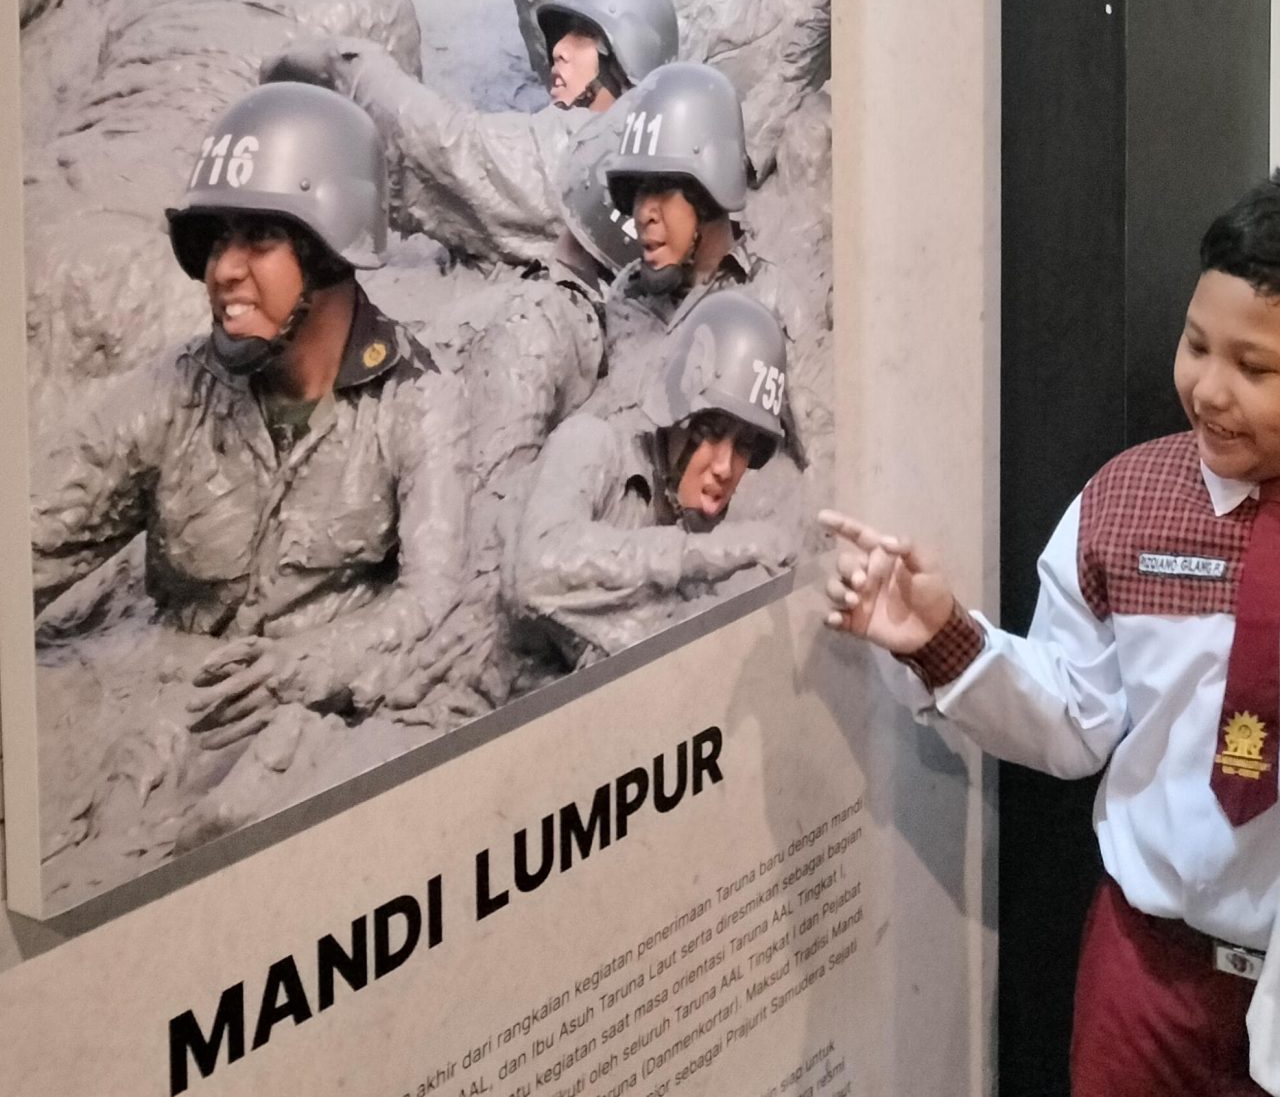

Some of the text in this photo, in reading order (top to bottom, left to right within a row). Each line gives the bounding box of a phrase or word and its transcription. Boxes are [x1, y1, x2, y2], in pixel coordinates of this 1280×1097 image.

[749, 359, 785, 416] 753
[169, 726, 724, 1097] MANDI LUMPUR
[416, 797, 863, 1097] akhir dari rangkaian kegiatan penerimaan Taruna baru dengan mandi
[498, 1052, 526, 1080] dan
[532, 1031, 554, 1059] Ibu
[559, 1005, 595, 1040] Asuh
[599, 973, 645, 1012] Taruna
[648, 950, 677, 981] Laut
[681, 927, 713, 959] serta
[715, 883, 779, 935] diresmikan
[782, 848, 825, 890] sebagai
[827, 826, 862, 860] bagian
[536, 1037, 597, 1090] kegiatan
[601, 1012, 630, 1045] saat
[634, 988, 669, 1023] masa
[672, 947, 726, 994] orientasi
[729, 919, 768, 954] Taruna
[772, 904, 794, 927] AAL
[797, 869, 838, 906] Tingkat
[589, 1053, 618, 1084] oleh
[622, 1016, 671, 1061] seluruh
[674, 985, 717, 1023] Taruna
[720, 964, 744, 992] AAL
[748, 932, 790, 970] Tingkat
[800, 913, 819, 936] dan
[822, 881, 862, 918] Pejabat
[746, 960, 790, 1001] Maksud
[794, 933, 829, 968] Tradisi
[831, 907, 863, 939] Mandi
[675, 1037, 723, 1085] sebagai
[726, 1005, 767, 1048] Prajurit
[771, 965, 826, 1014] Samudera
